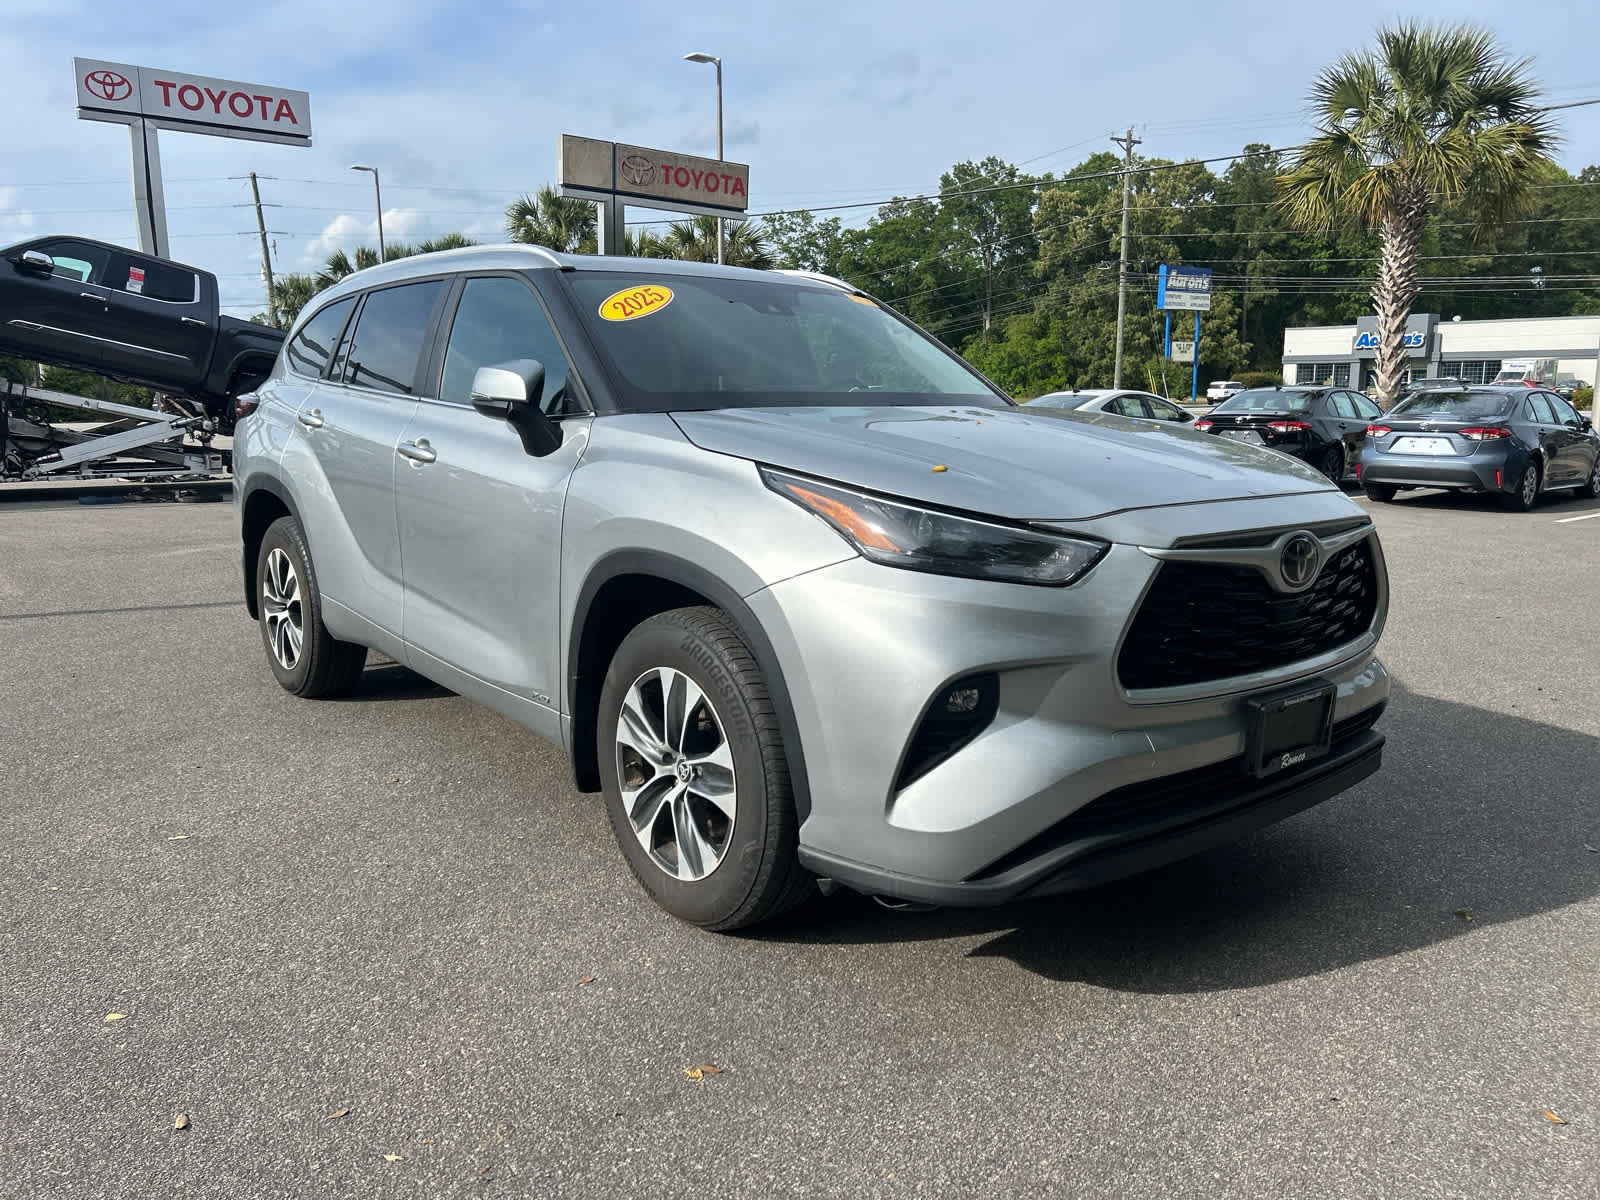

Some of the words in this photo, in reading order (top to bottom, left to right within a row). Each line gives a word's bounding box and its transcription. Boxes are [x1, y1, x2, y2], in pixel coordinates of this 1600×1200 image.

[154, 80, 298, 124] TOYOTA
[661, 164, 746, 197] TOYOTA
[613, 288, 664, 317] 2025
[1355, 331, 1425, 348] Aan's
[680, 635, 754, 744] BRIDGESTONE
